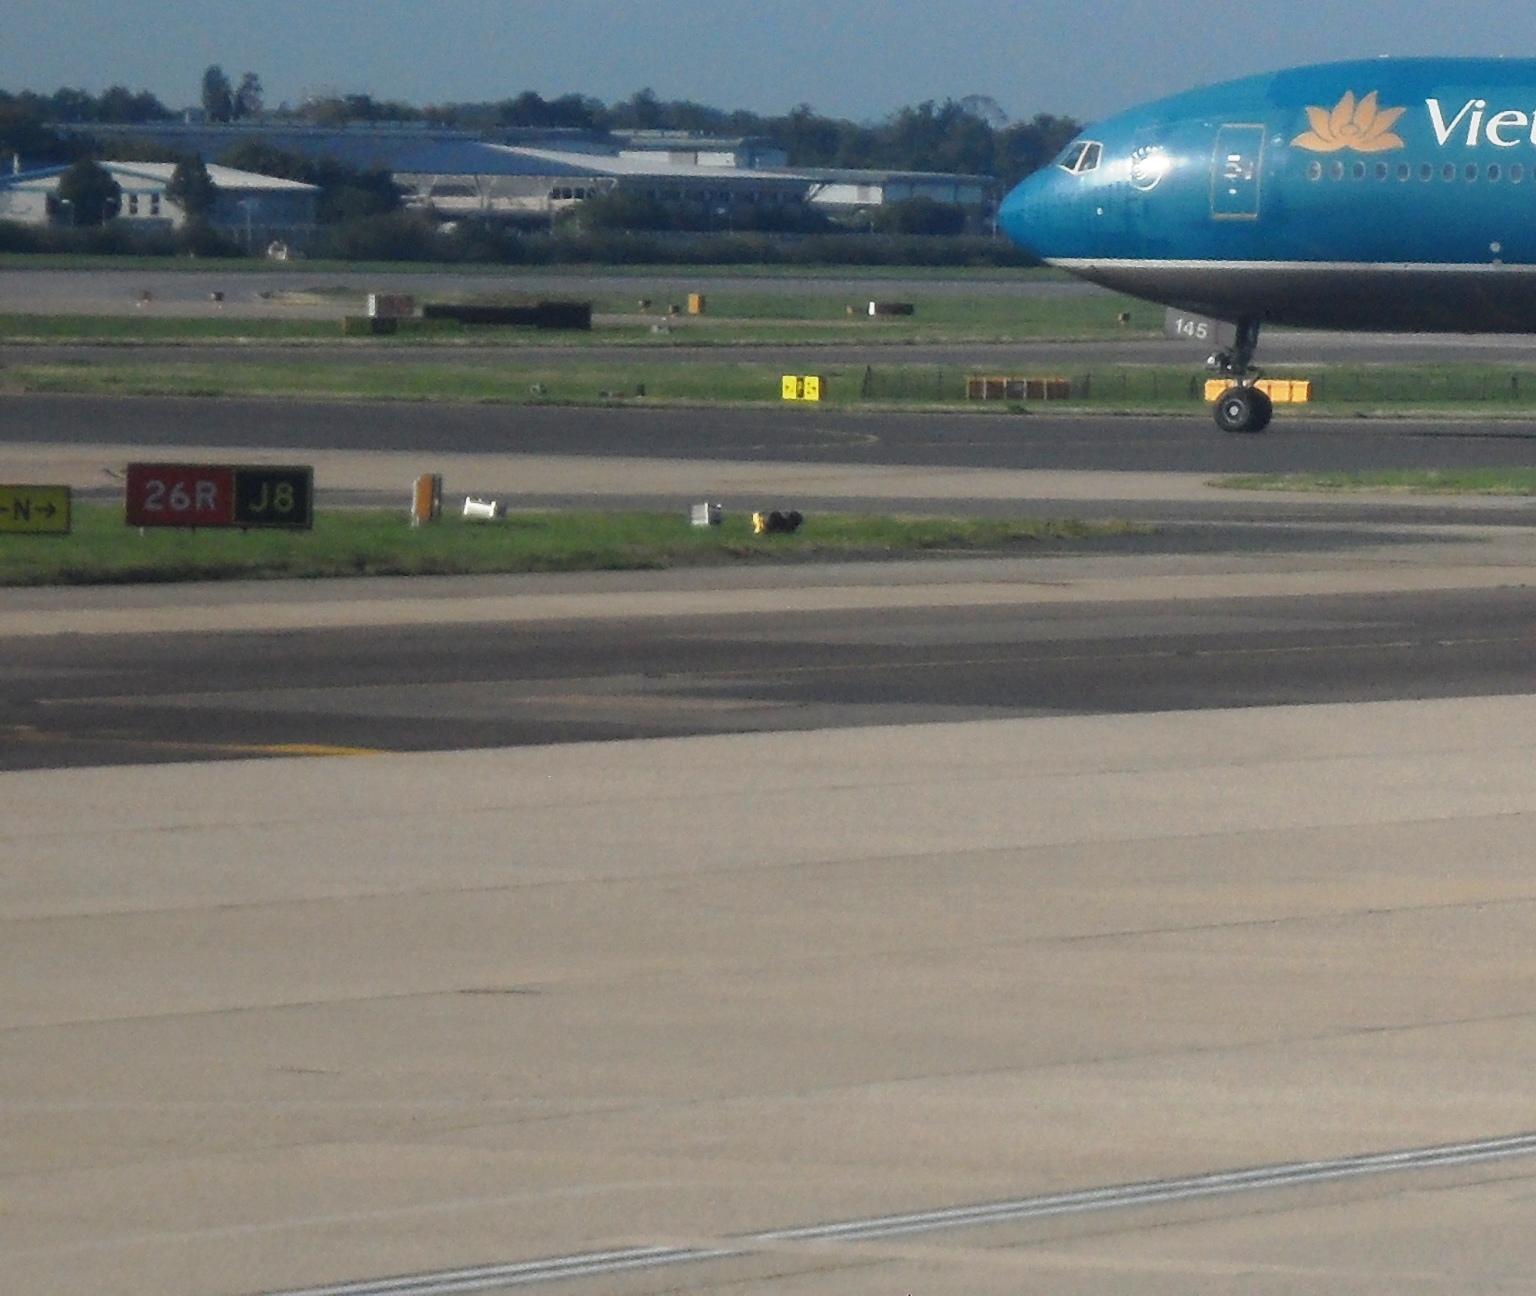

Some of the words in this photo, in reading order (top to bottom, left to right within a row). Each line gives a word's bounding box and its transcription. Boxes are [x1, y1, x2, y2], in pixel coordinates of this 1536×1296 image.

[1176, 318, 1208, 339] 145
[144, 480, 217, 512] 26R
[250, 482, 294, 513] J8
[13, 498, 31, 521] N
